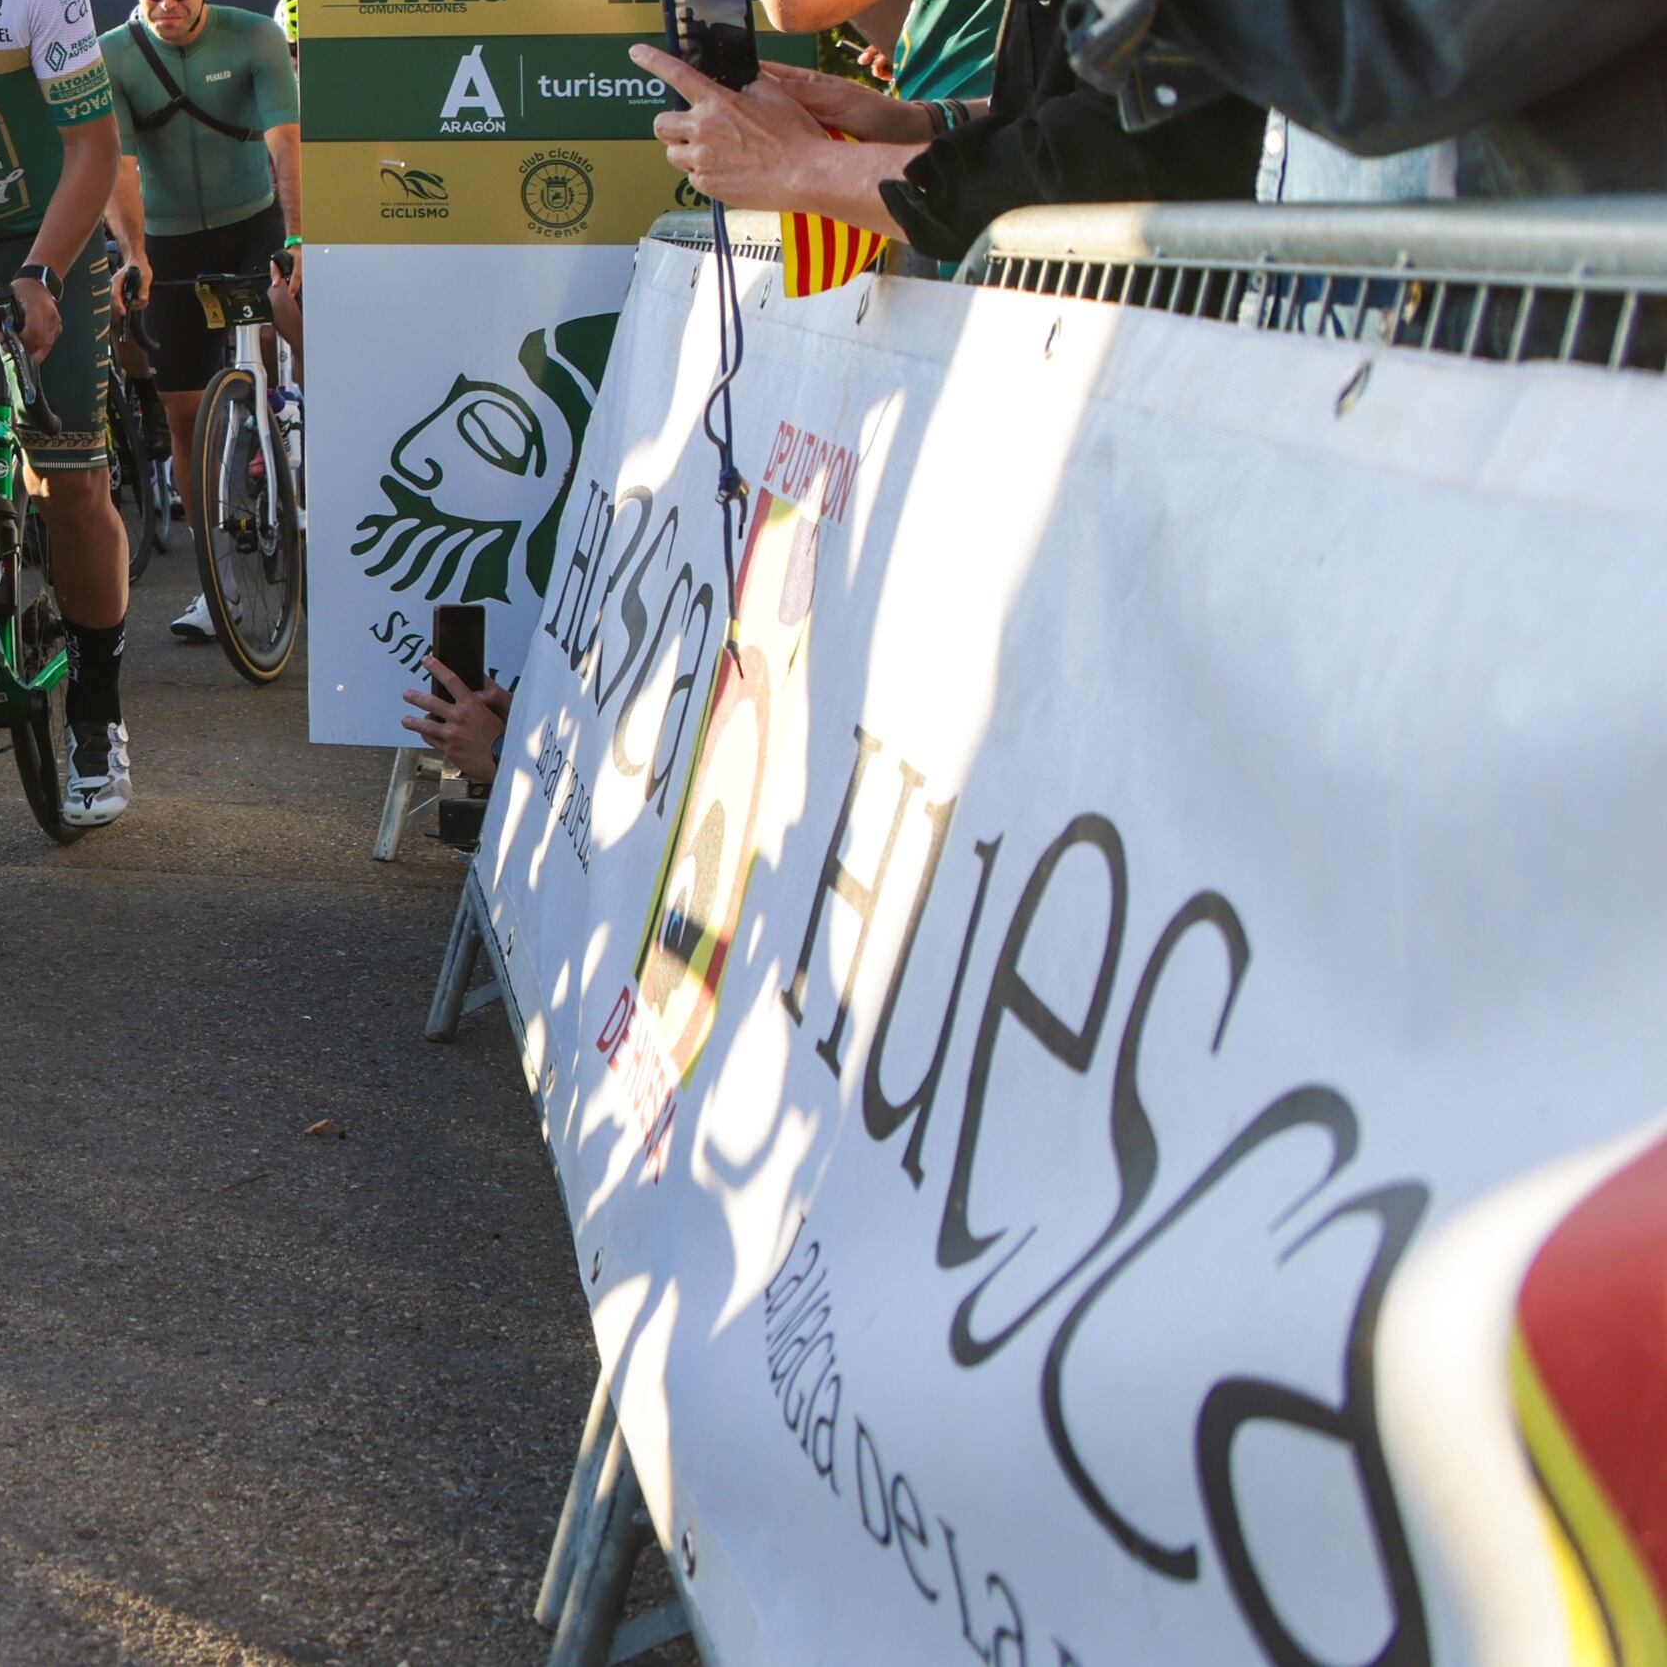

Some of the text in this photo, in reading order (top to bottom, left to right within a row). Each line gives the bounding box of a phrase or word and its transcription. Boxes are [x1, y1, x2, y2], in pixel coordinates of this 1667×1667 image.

[359, 3, 467, 15] COMUNICACIONES
[538, 72, 665, 98] turismo
[440, 117, 506, 133] ARAGÓN
[519, 147, 594, 174] club ciclista
[380, 208, 449, 219] CICLISMO
[528, 220, 588, 238] oscense
[243, 305, 253, 318] 3
